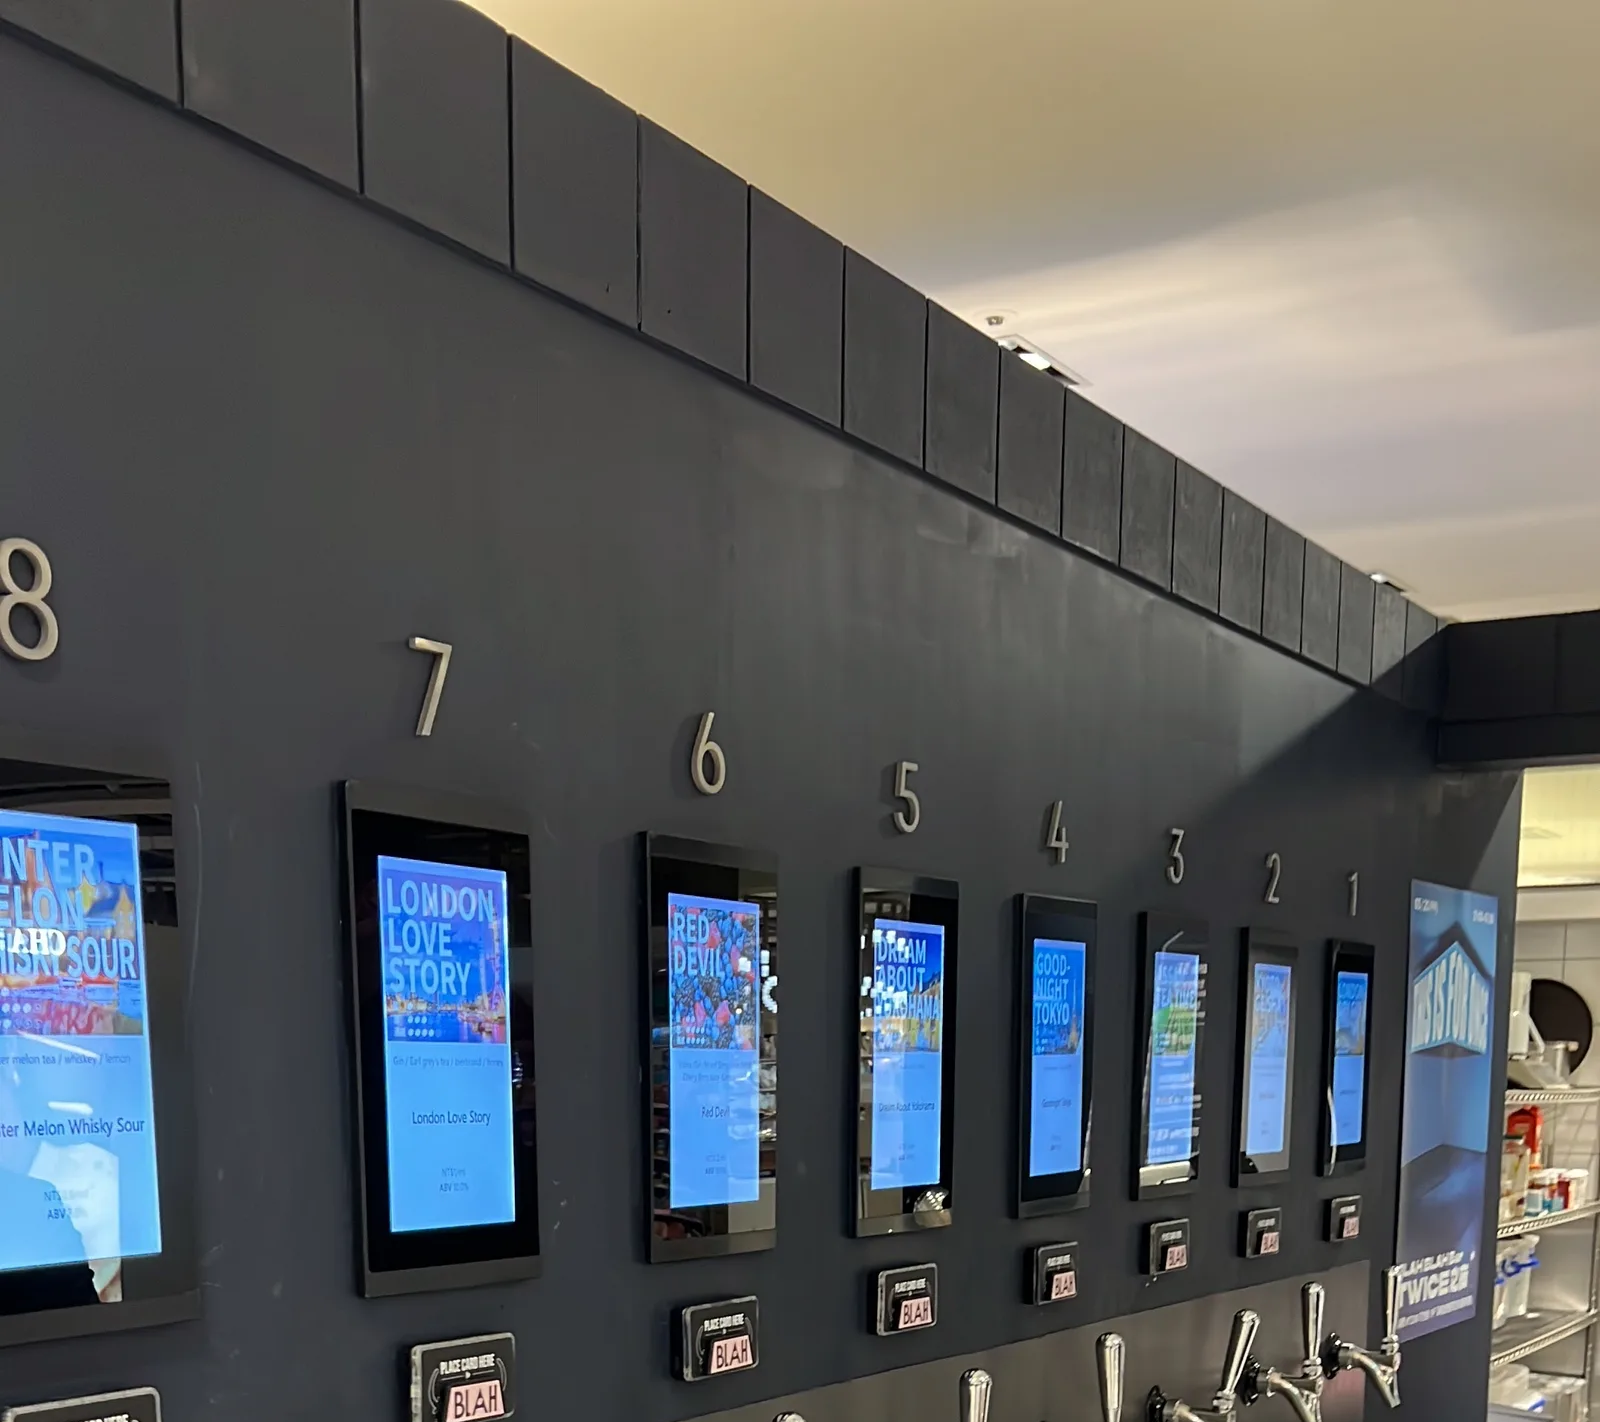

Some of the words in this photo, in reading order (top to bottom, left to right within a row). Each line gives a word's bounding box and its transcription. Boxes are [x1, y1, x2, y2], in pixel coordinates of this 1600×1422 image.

[0, 537, 59, 660] 8
[408, 636, 452, 737] 7
[691, 711, 726, 795] 6
[893, 761, 920, 833] 5
[1046, 800, 1069, 863] 4
[0, 837, 96, 885] NTER
[1166, 827, 1185, 884] 3
[1265, 852, 1280, 904] 2
[1348, 871, 1359, 917] 1
[0, 885, 85, 931] ELON
[387, 878, 493, 922] LONDON
[388, 917, 453, 957] LOVE
[673, 912, 709, 944] RED
[67, 935, 138, 980] SOUR
[673, 945, 725, 978] DEVIL
[877, 937, 926, 965] DREAM
[389, 956, 471, 996] STORY
[876, 964, 926, 993] ABOUT
[1036, 977, 1069, 1000] NIGHT
[1034, 1002, 1070, 1026] TOKYO
[0, 1124, 19, 1138] ter
[24, 1119, 65, 1137] Melon
[68, 1117, 114, 1138] Whisky
[117, 1116, 145, 1133] Sour
[412, 1111, 445, 1125] London
[447, 1111, 467, 1124] Love
[469, 1110, 491, 1126] Story
[701, 1106, 713, 1118] Red
[715, 1105, 730, 1118] Devil
[903, 1300, 929, 1325] BLAH
[440, 1359, 461, 1375] PLACE
[478, 1353, 496, 1369] HERE
[716, 1338, 748, 1369] BLAH
[454, 1384, 498, 1419] BLAH
